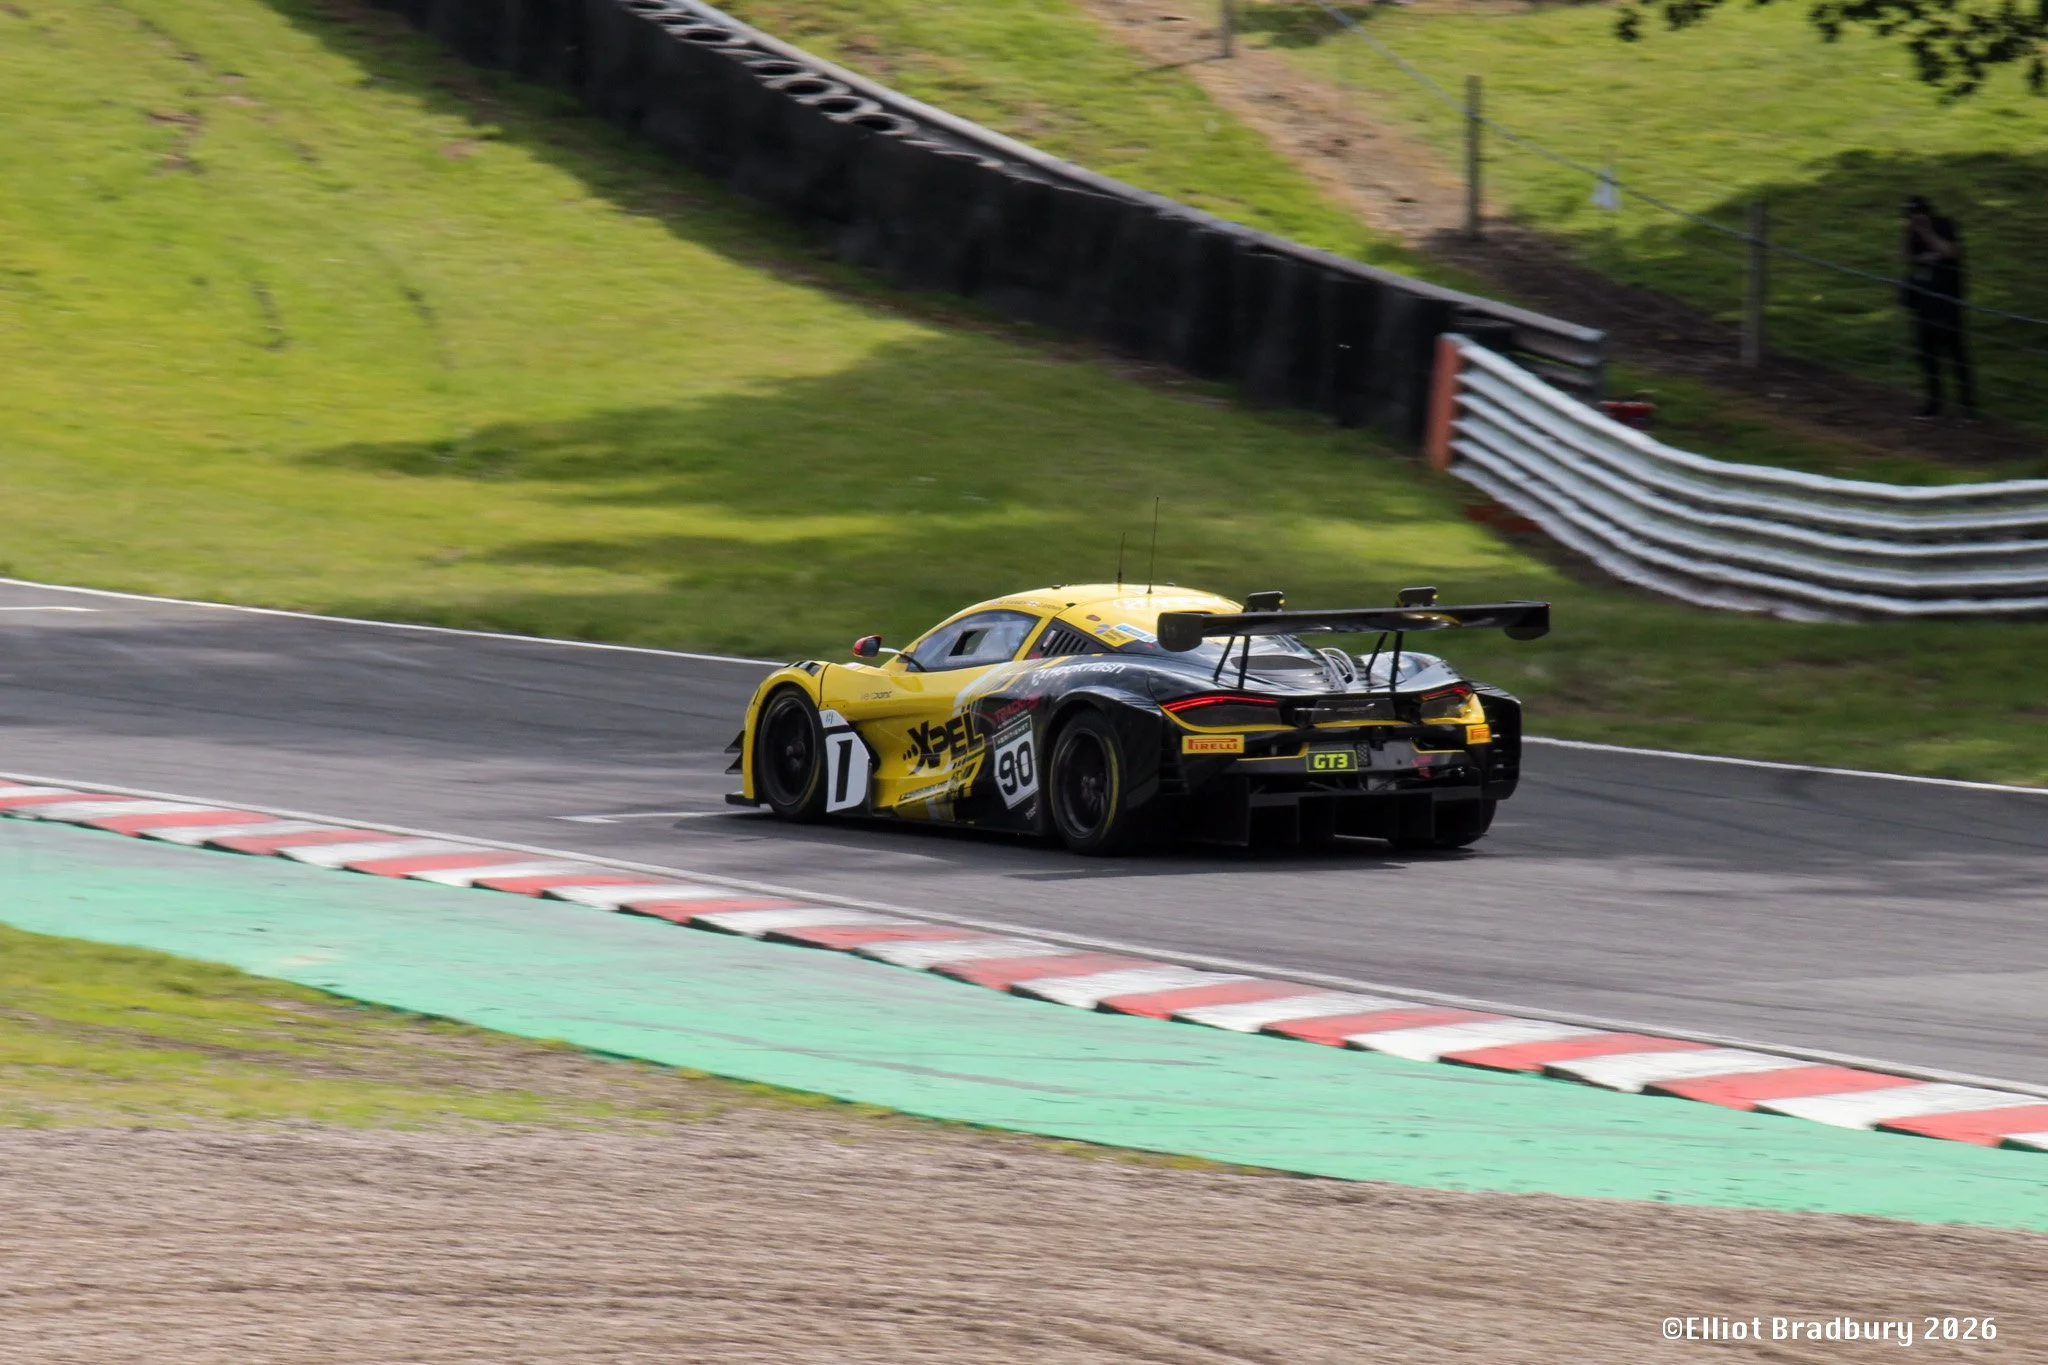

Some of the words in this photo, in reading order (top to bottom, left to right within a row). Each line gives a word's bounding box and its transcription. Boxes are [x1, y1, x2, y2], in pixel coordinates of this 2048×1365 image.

[835, 739, 853, 803] 1
[906, 712, 984, 775] XPEL
[998, 740, 1034, 796] 90
[1187, 738, 1238, 750] PIRELLI
[1314, 753, 1349, 769] GT3
